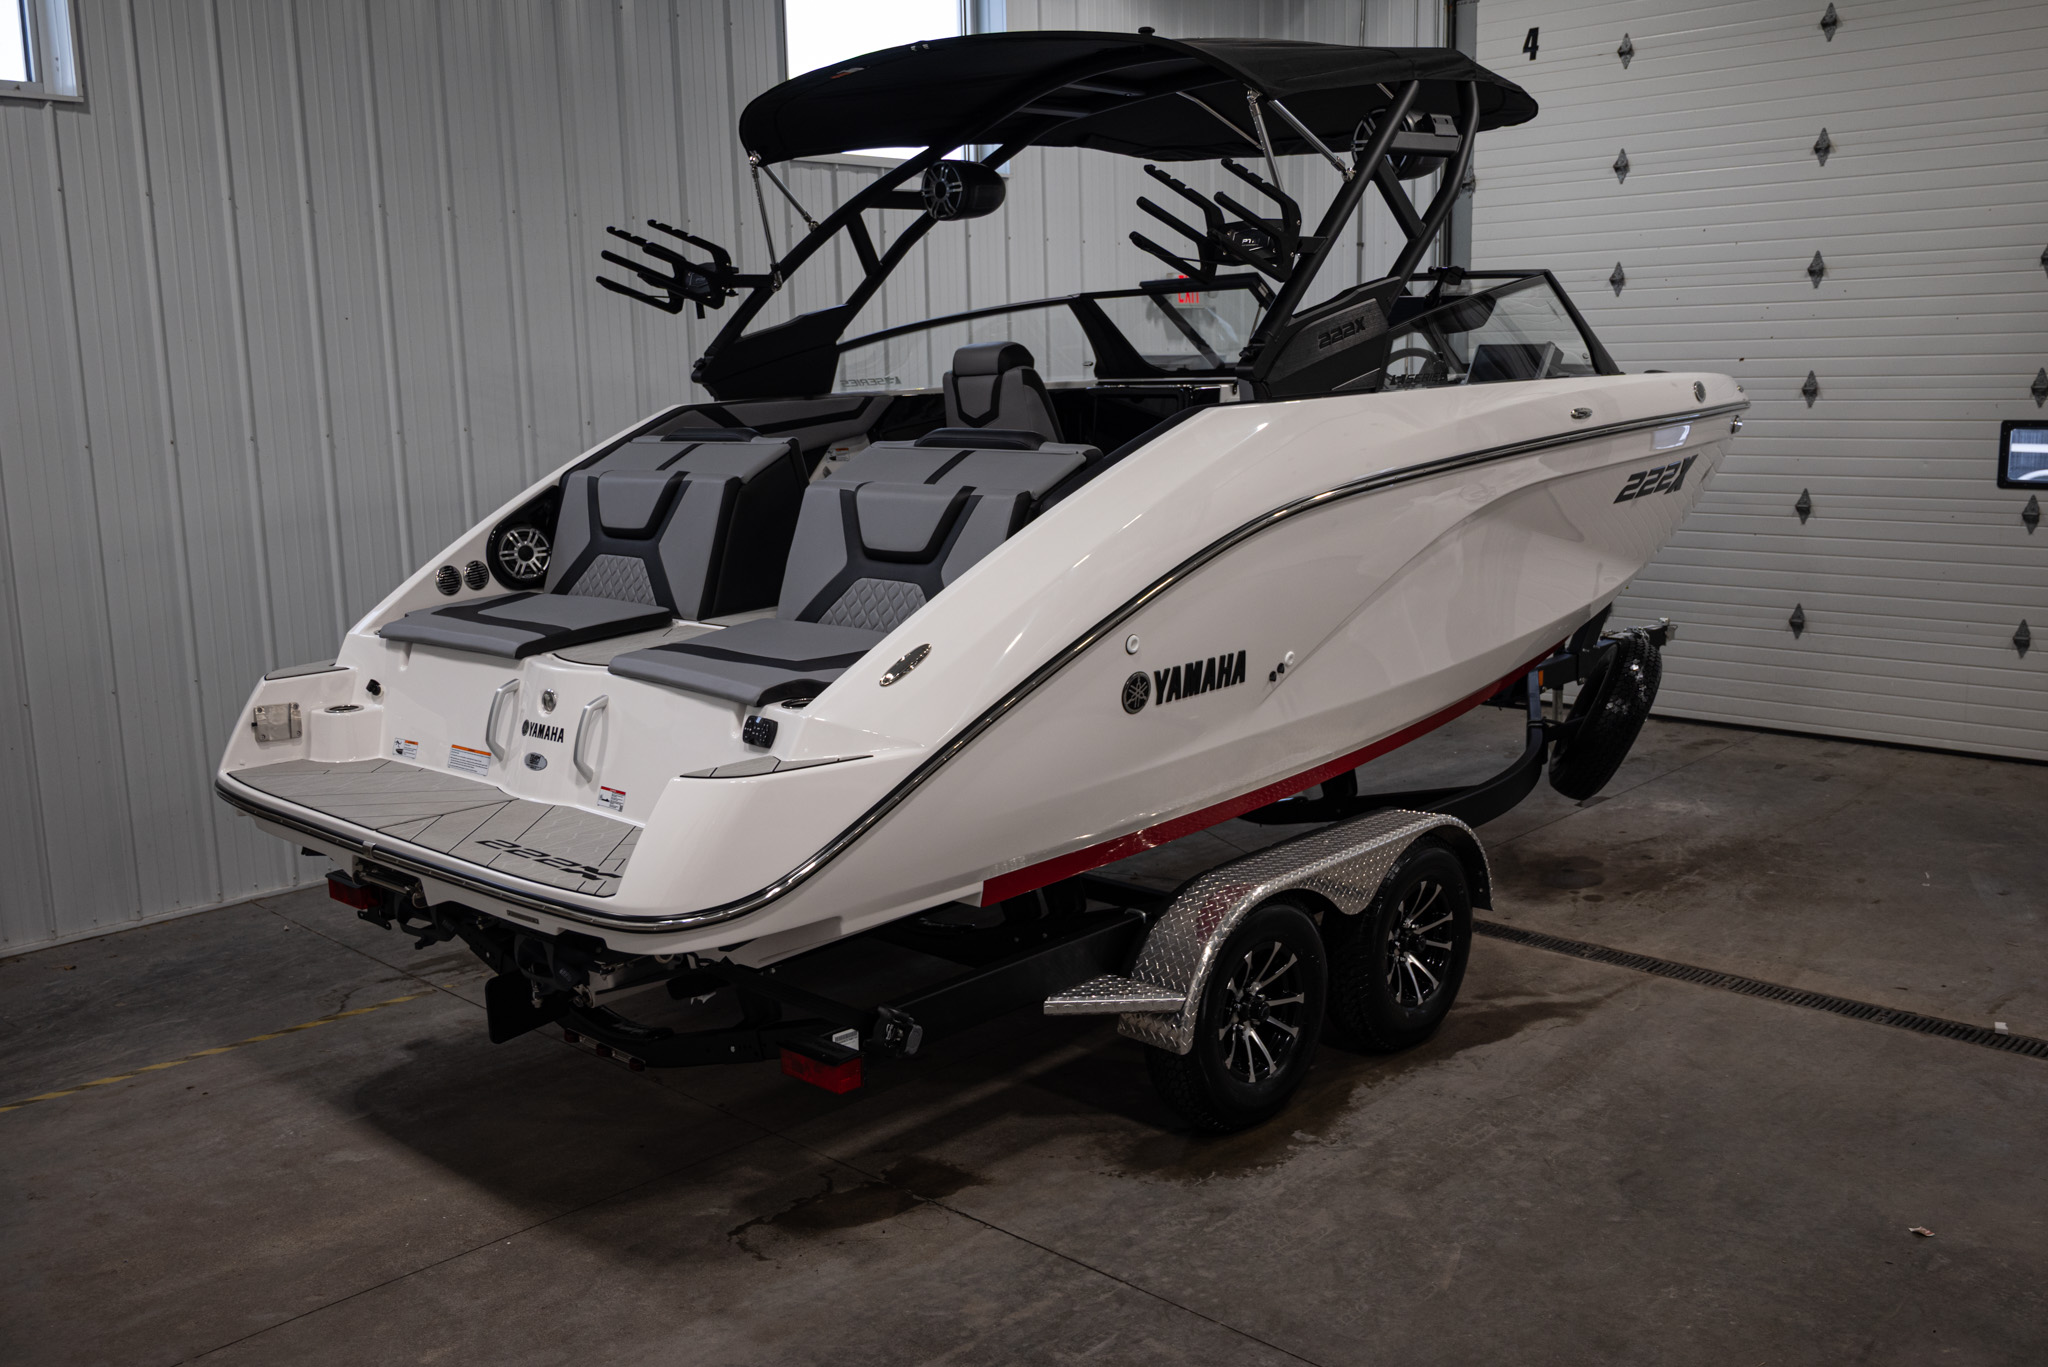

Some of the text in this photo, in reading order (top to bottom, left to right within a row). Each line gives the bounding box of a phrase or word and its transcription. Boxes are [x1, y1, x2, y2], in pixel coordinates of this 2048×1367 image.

[1523, 27, 1539, 61] 4
[1318, 316, 1366, 349] 222X
[1613, 454, 1698, 504] 222X
[1154, 650, 1246, 705] YAMAHA
[529, 722, 564, 743] YAMAHA
[475, 840, 622, 880] 222X
